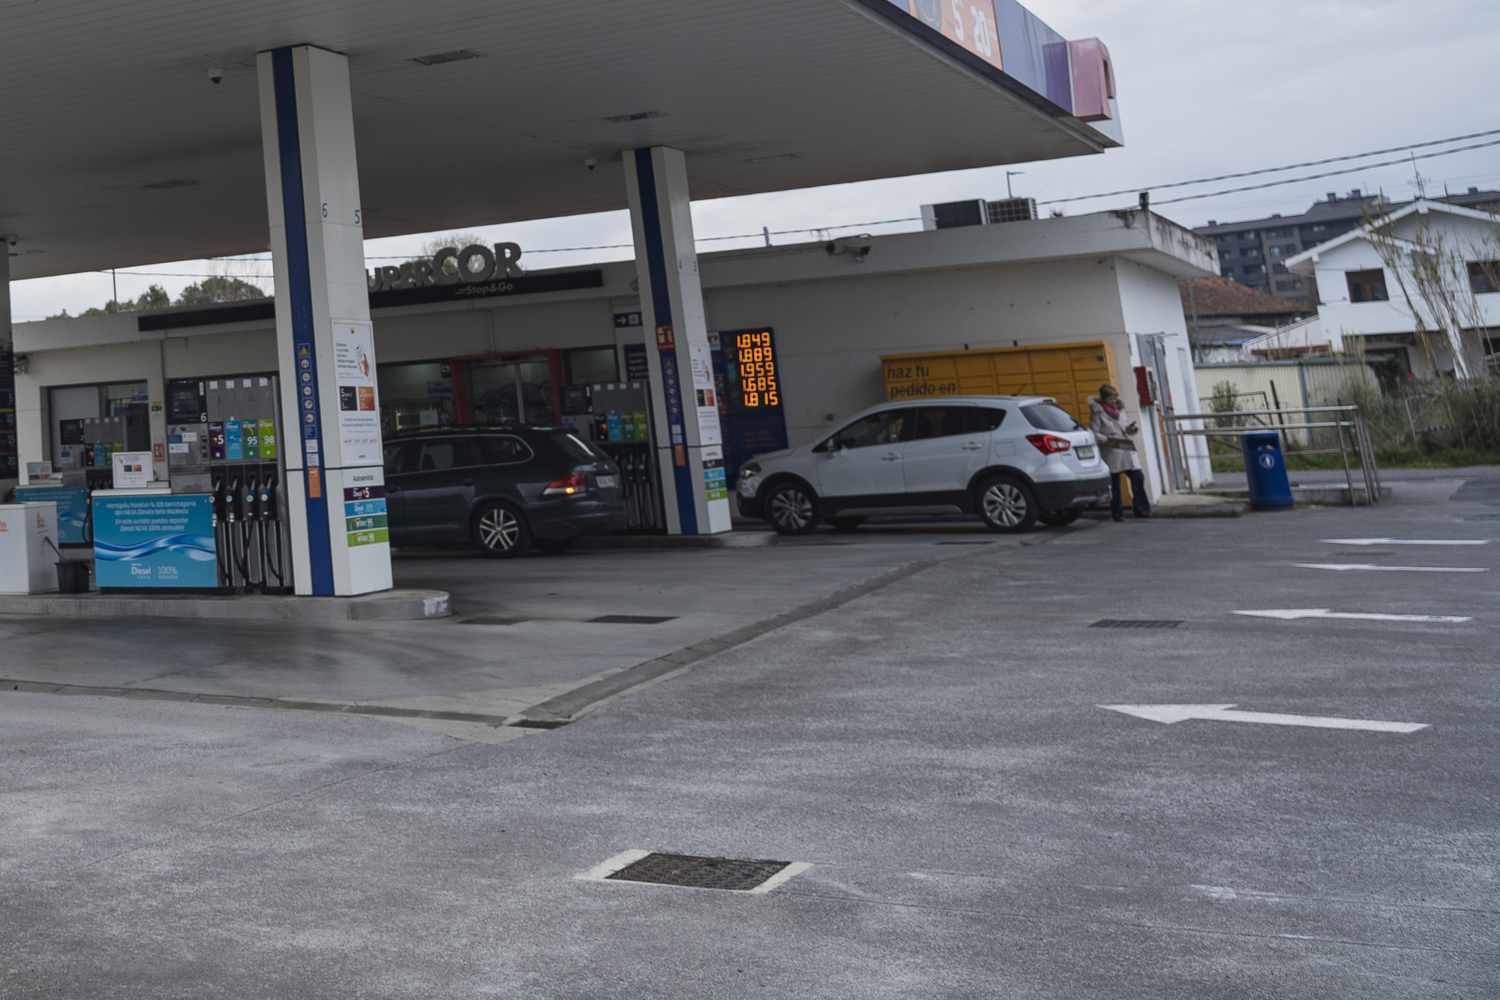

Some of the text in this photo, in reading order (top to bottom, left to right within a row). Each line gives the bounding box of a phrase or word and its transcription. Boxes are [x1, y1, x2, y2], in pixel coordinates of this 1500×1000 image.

[969, 4, 992, 58] 20
[322, 202, 361, 224] 6 5
[366, 241, 525, 293] UPERCOR
[464, 281, 514, 296] Stop&Go
[737, 332, 771, 348] 1.849
[886, 364, 930, 380] haz tu
[890, 381, 956, 400] pedido en
[200, 412, 207, 422] 6
[218, 434, 224, 445] 5
[247, 436, 258, 445] 95
[264, 435, 275, 444] 98
[365, 487, 370, 498] 5
[131, 566, 178, 575] Diesel 100%
